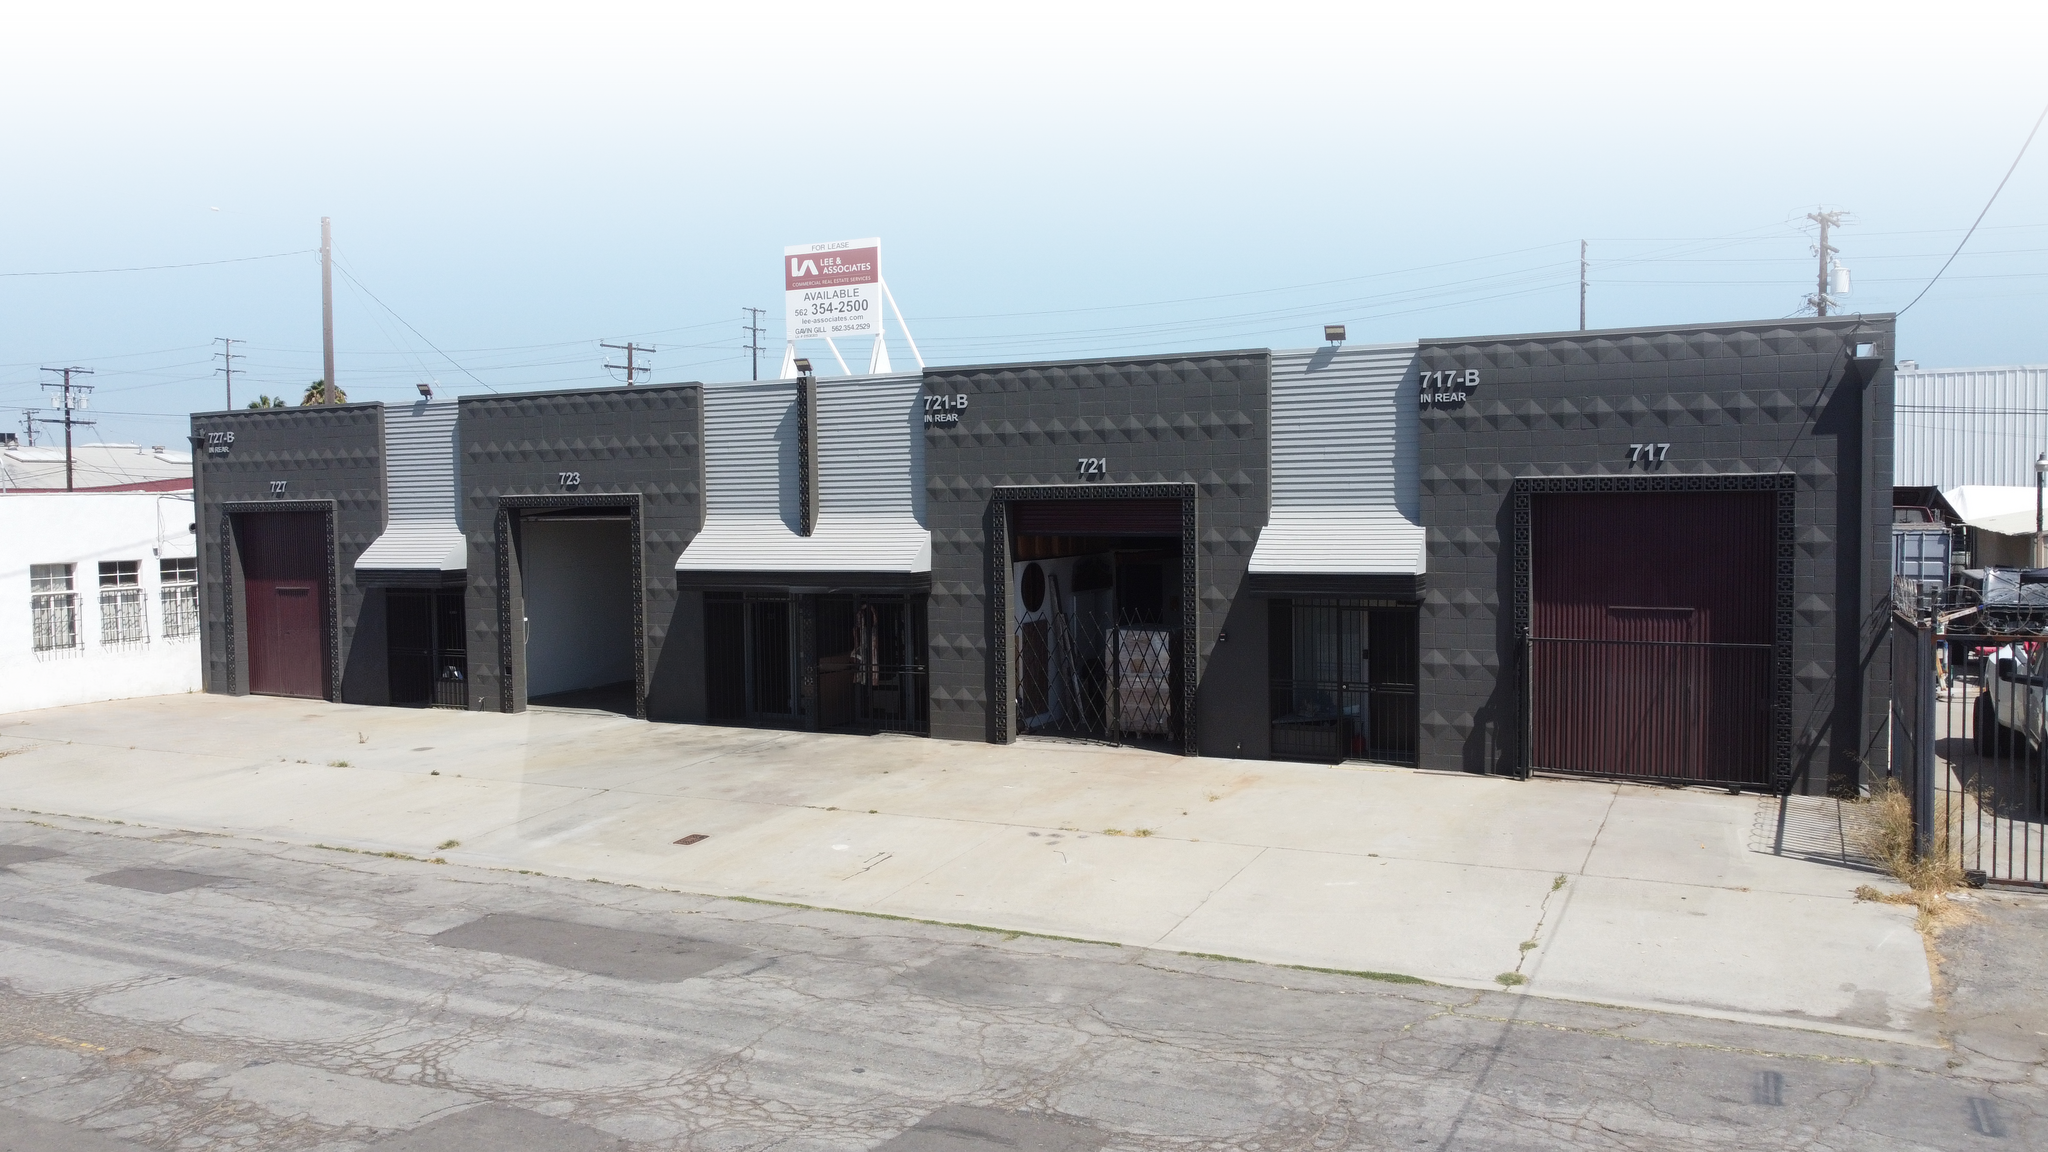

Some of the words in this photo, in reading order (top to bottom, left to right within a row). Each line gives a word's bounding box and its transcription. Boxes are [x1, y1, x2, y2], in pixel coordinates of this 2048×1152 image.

[827, 242, 849, 250] LEASE
[820, 258, 833, 266] LEE
[836, 257, 841, 265] &
[823, 263, 870, 274] ASSOCIATES
[804, 288, 859, 301] AVAILABLE
[812, 299, 868, 315] 354-2500
[802, 315, 863, 324] lee-associates.com
[1420, 369, 1480, 388] 717-B
[923, 393, 969, 410] 721-B
[1420, 393, 1432, 403] IN
[1435, 392, 1467, 402] REAR
[924, 414, 933, 423] IN
[934, 413, 959, 422] REAR
[208, 431, 235, 444] 727-B
[1630, 443, 1670, 462] 717
[1078, 457, 1106, 473] 721
[559, 471, 580, 485] 723
[270, 480, 287, 493] 727
